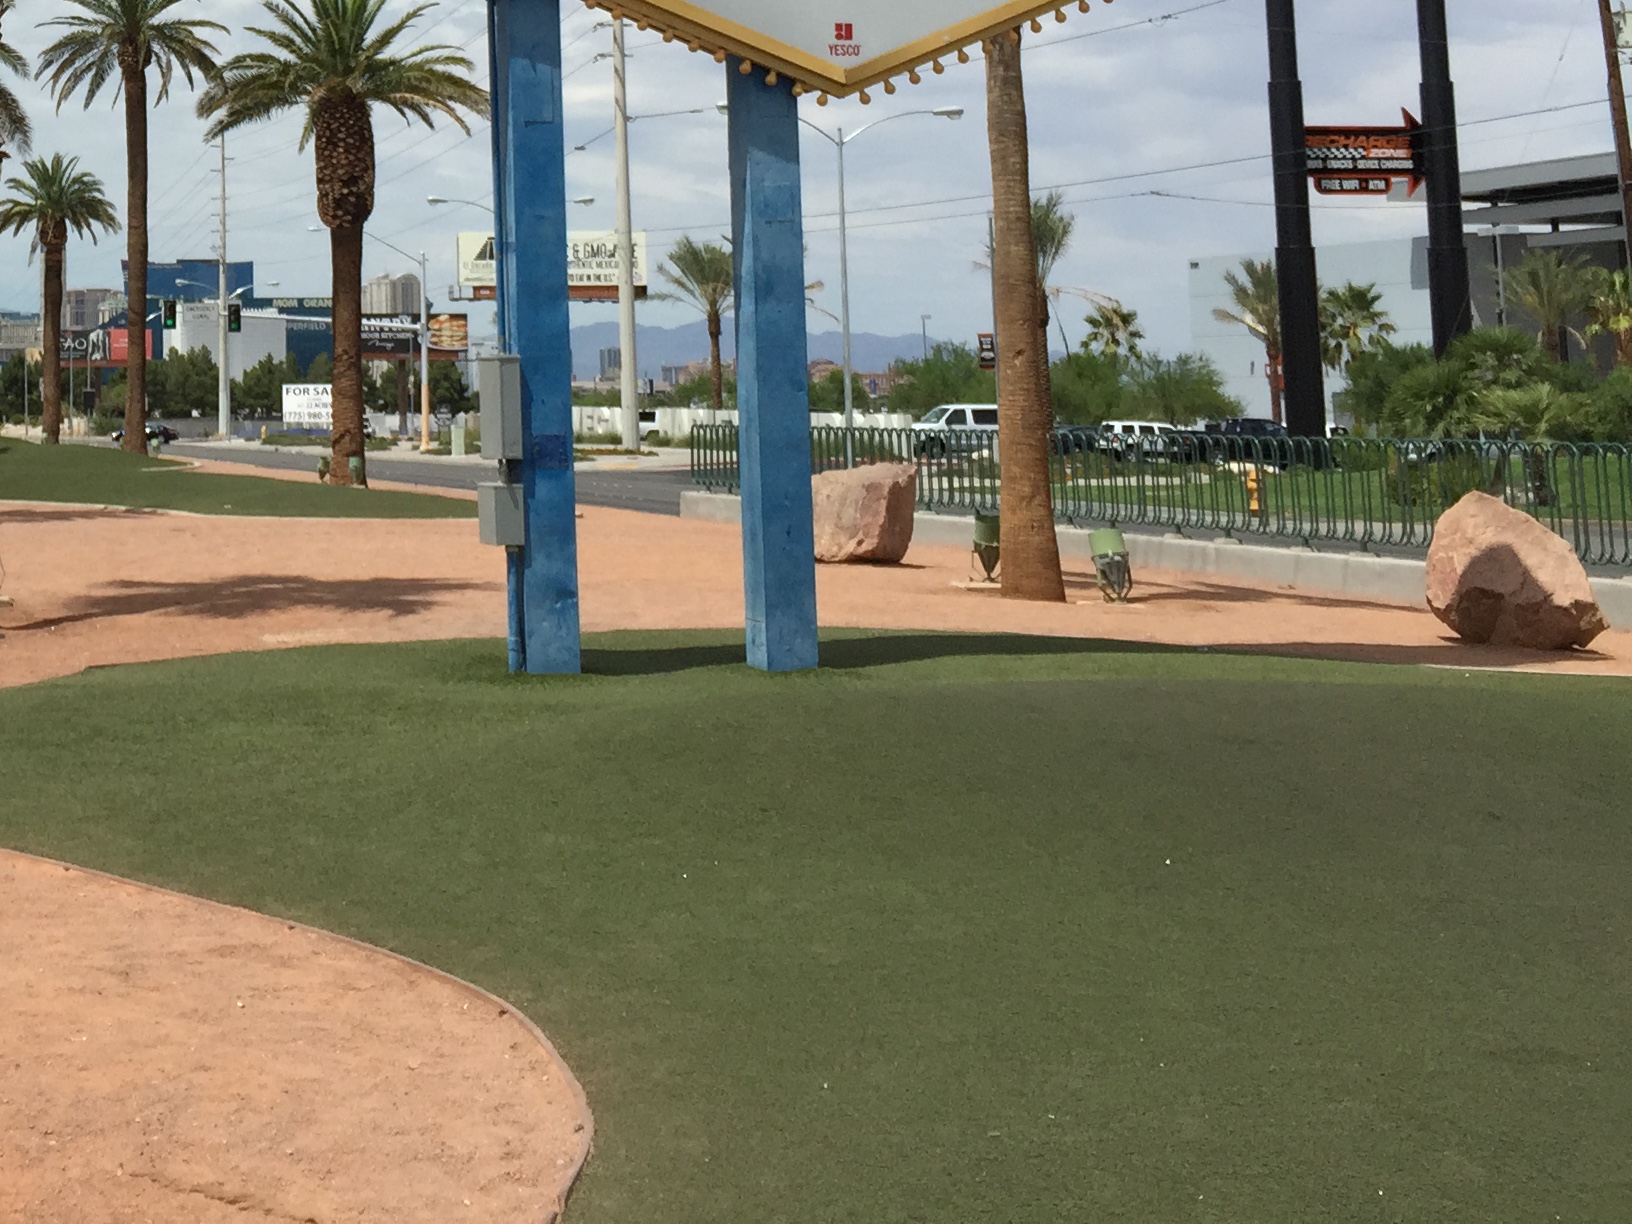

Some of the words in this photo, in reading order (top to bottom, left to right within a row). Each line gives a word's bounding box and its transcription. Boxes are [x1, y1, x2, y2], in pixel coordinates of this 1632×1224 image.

[828, 43, 861, 57] YESCO
[1321, 178, 1341, 190] FREE
[1368, 178, 1387, 190] ATM
[303, 298, 333, 308] GRAN
[285, 387, 310, 396] FOR
